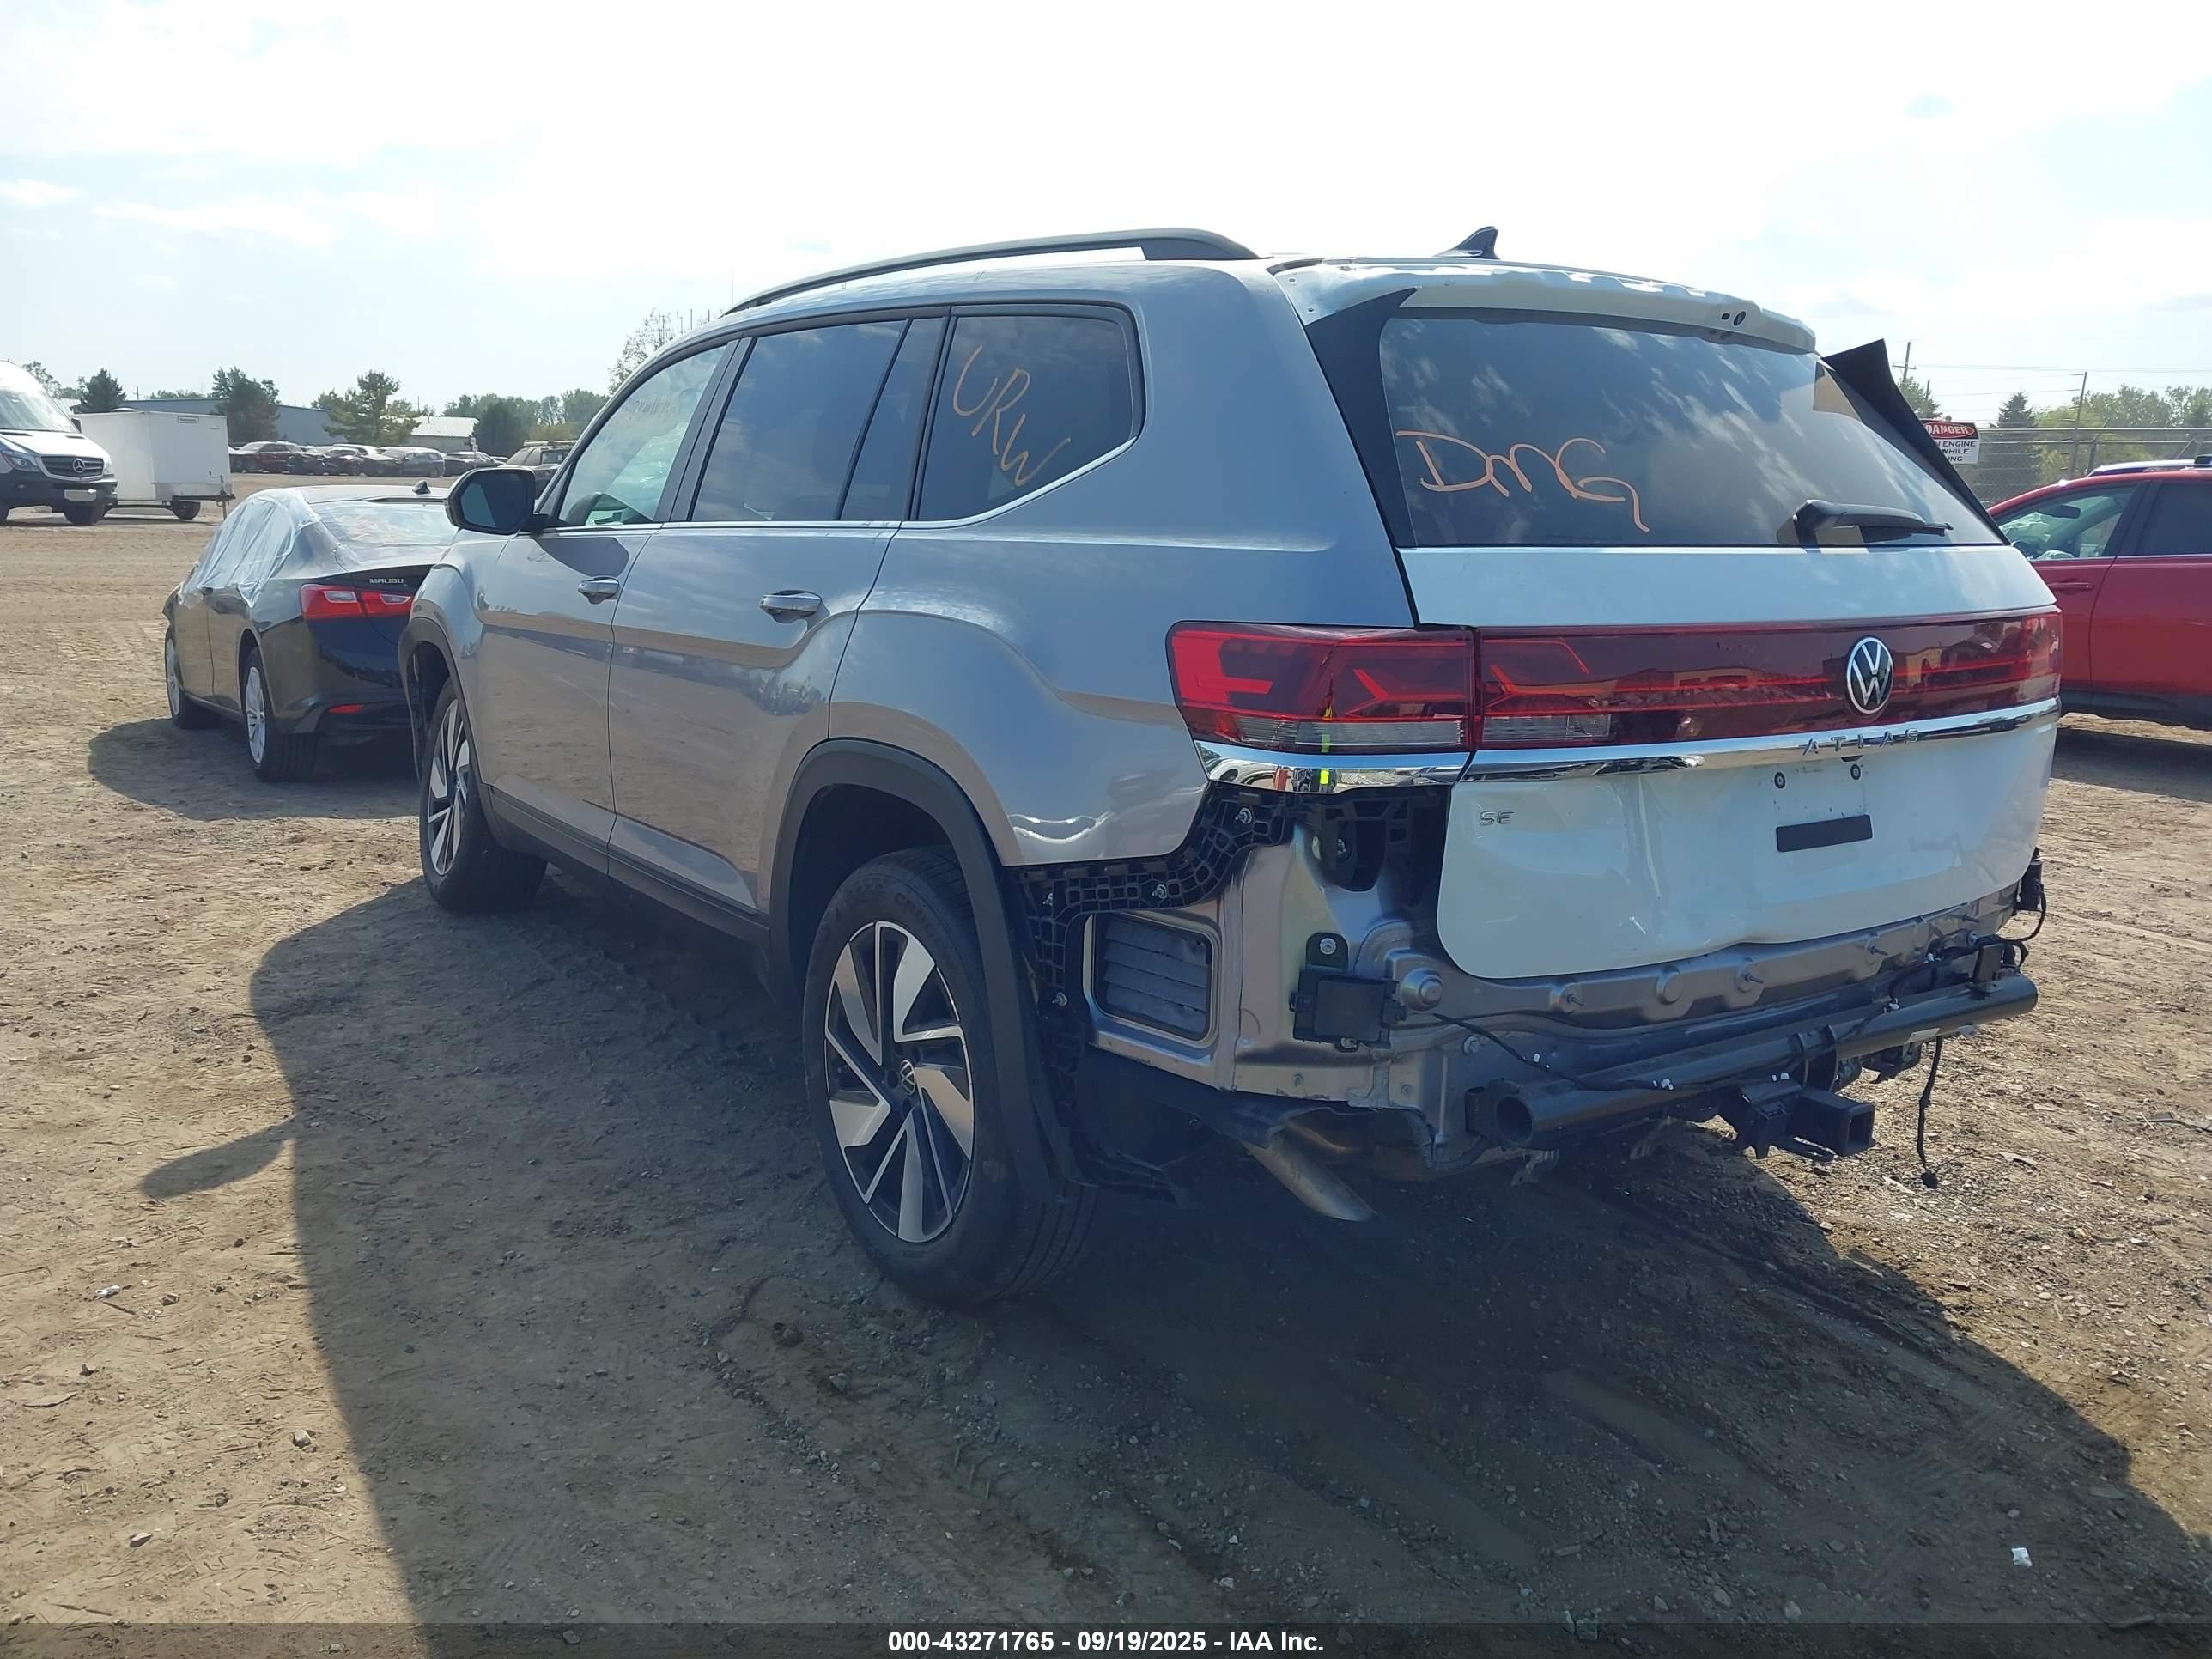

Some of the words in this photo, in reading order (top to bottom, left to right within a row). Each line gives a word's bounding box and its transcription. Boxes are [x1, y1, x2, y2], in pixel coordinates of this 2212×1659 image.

[1924, 424, 1969, 434] DANGER
[1802, 728, 1918, 756] ATLAS
[1480, 811, 1515, 825] SE
